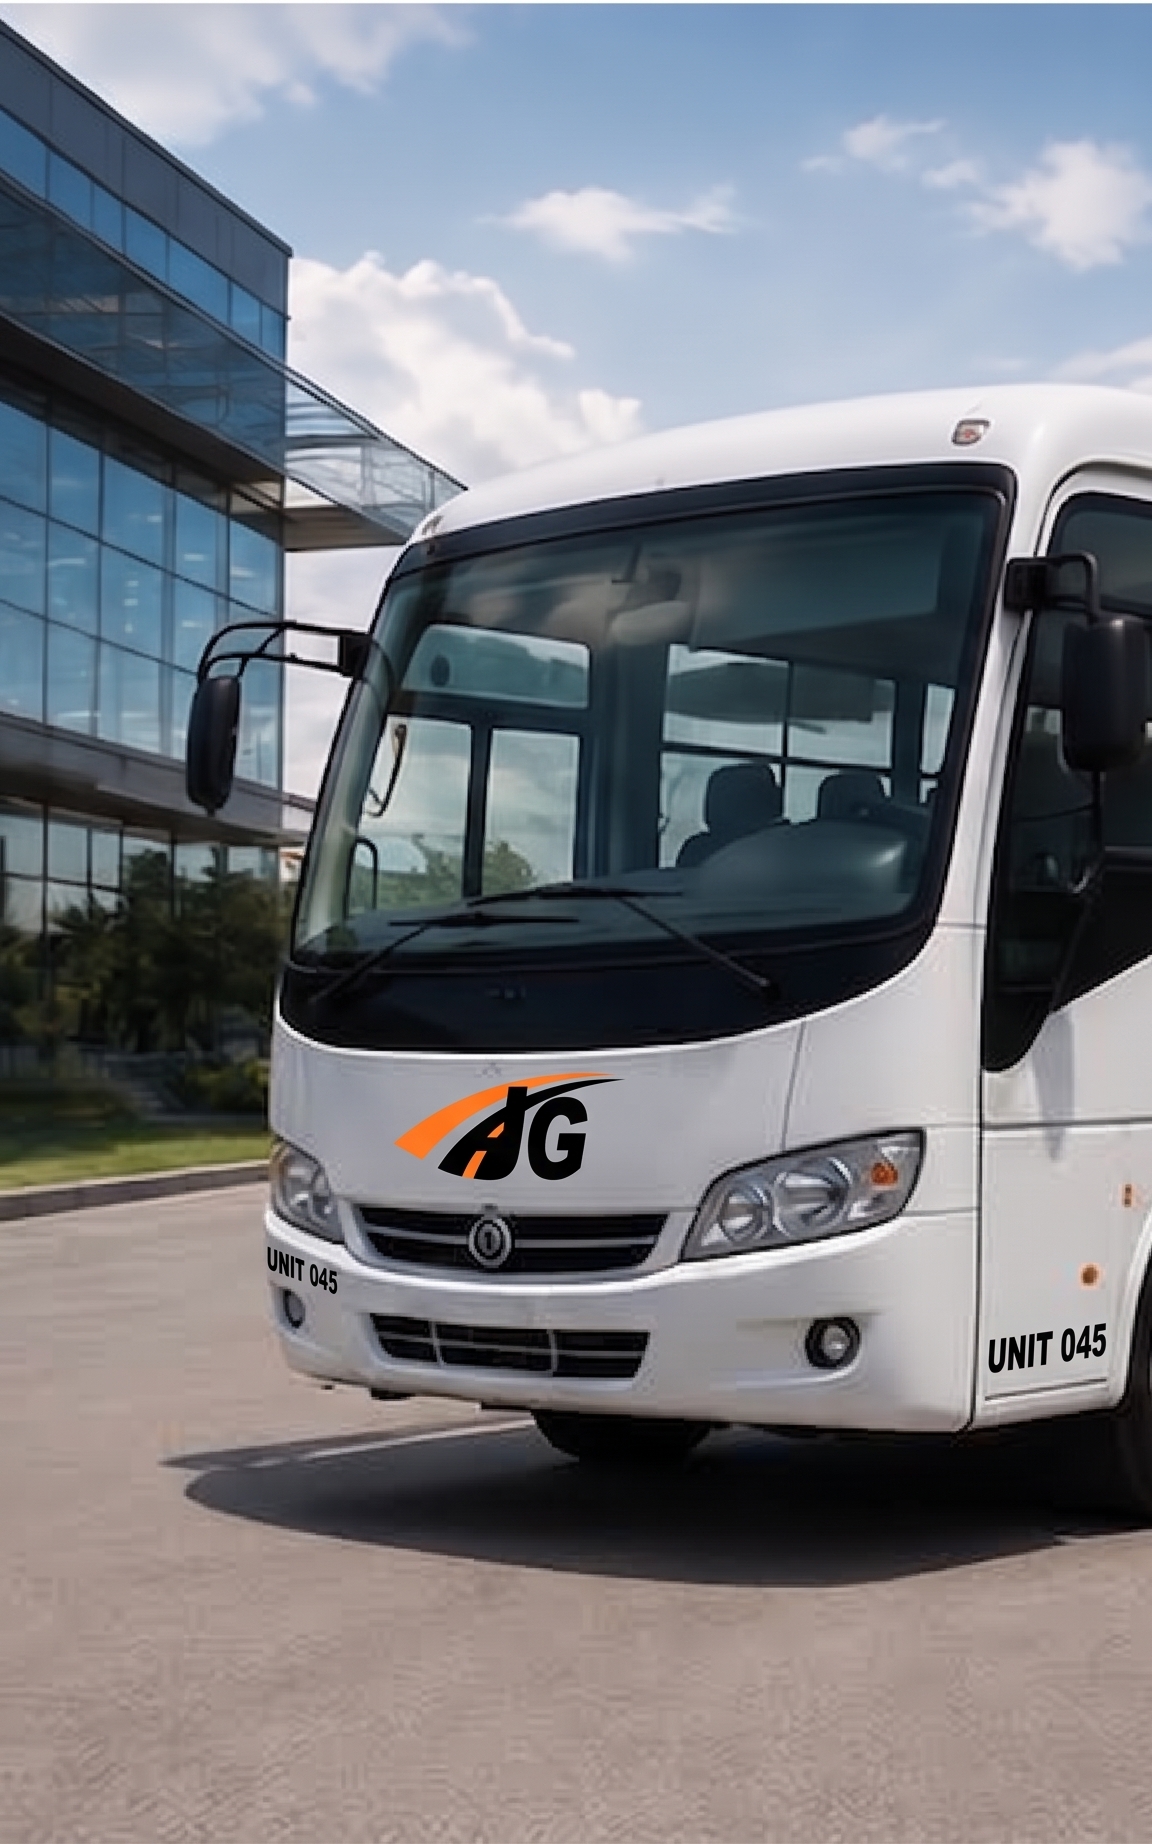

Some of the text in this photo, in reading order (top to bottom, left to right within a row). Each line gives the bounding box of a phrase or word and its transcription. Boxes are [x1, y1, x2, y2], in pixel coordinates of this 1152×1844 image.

[267, 1246, 338, 1295] UNIT 045
[988, 1322, 1107, 1374] UNIT 045
